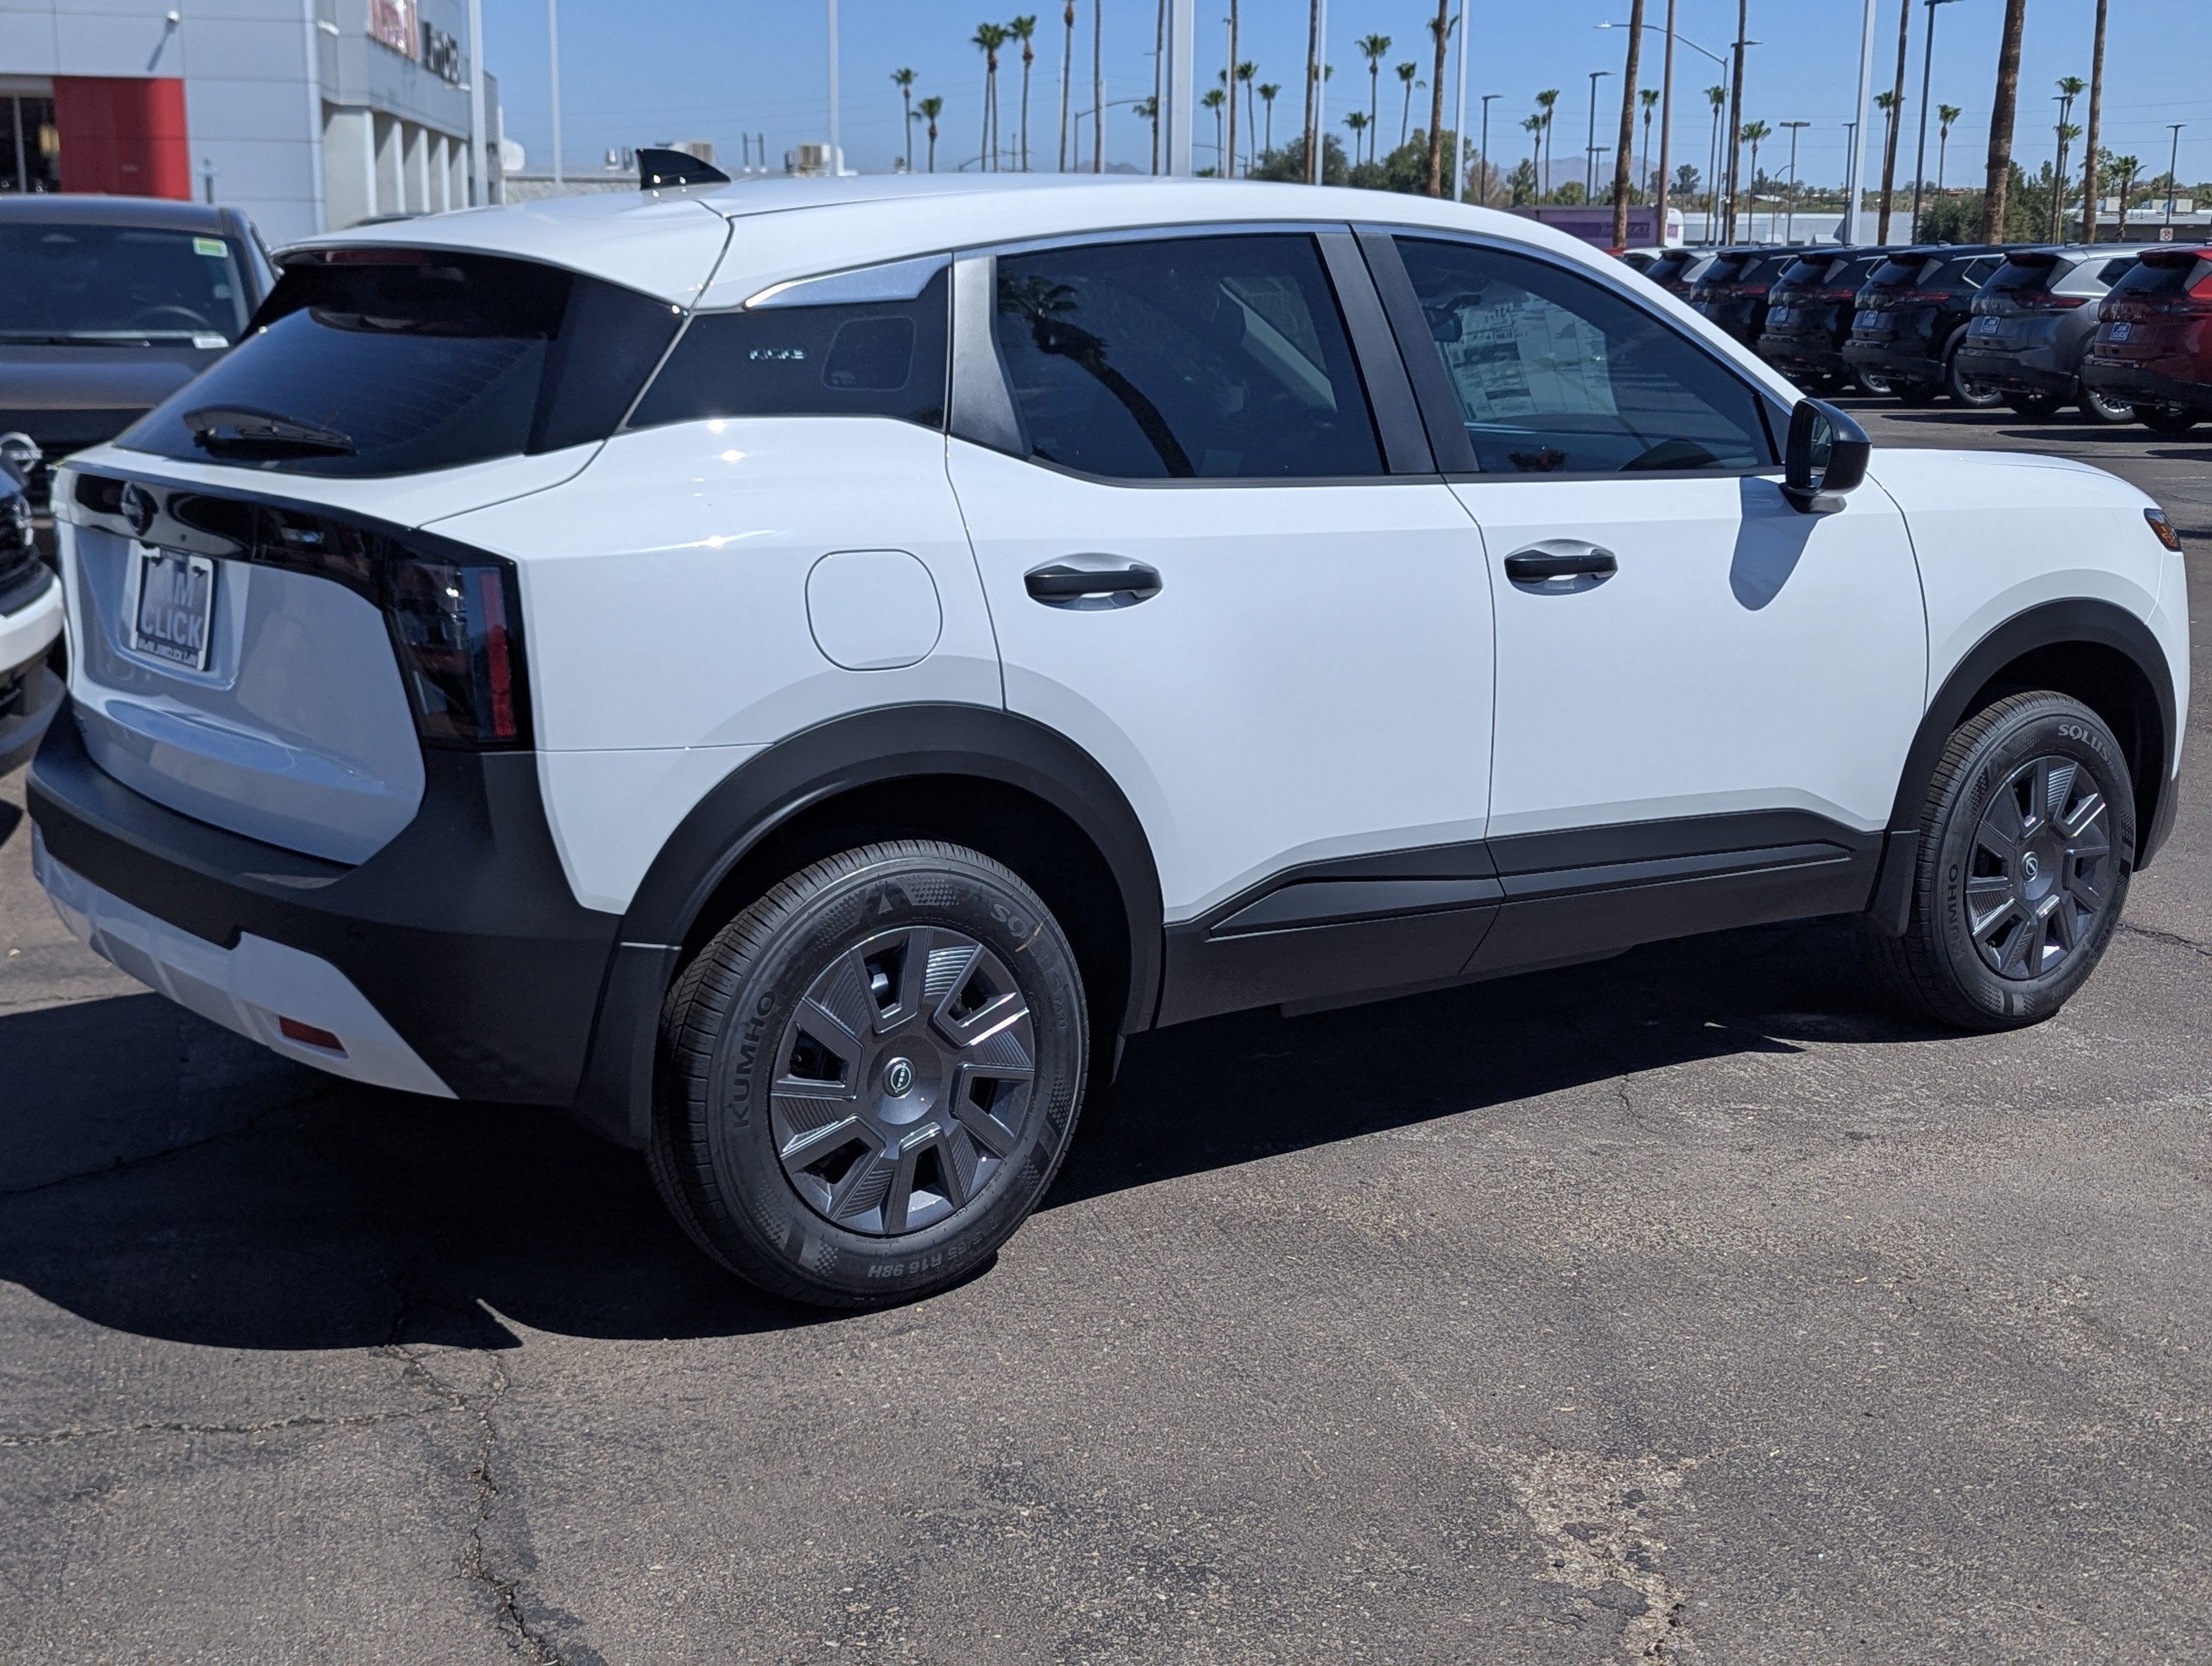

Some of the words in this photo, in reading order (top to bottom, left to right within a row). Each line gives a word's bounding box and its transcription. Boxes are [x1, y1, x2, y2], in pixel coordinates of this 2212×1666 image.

[140, 604, 203, 649] CLICK
[2057, 724, 2111, 761] SOLUS
[733, 991, 775, 1129] KUMHO
[867, 1264, 905, 1278] 98H
[909, 1253, 942, 1272] R16
